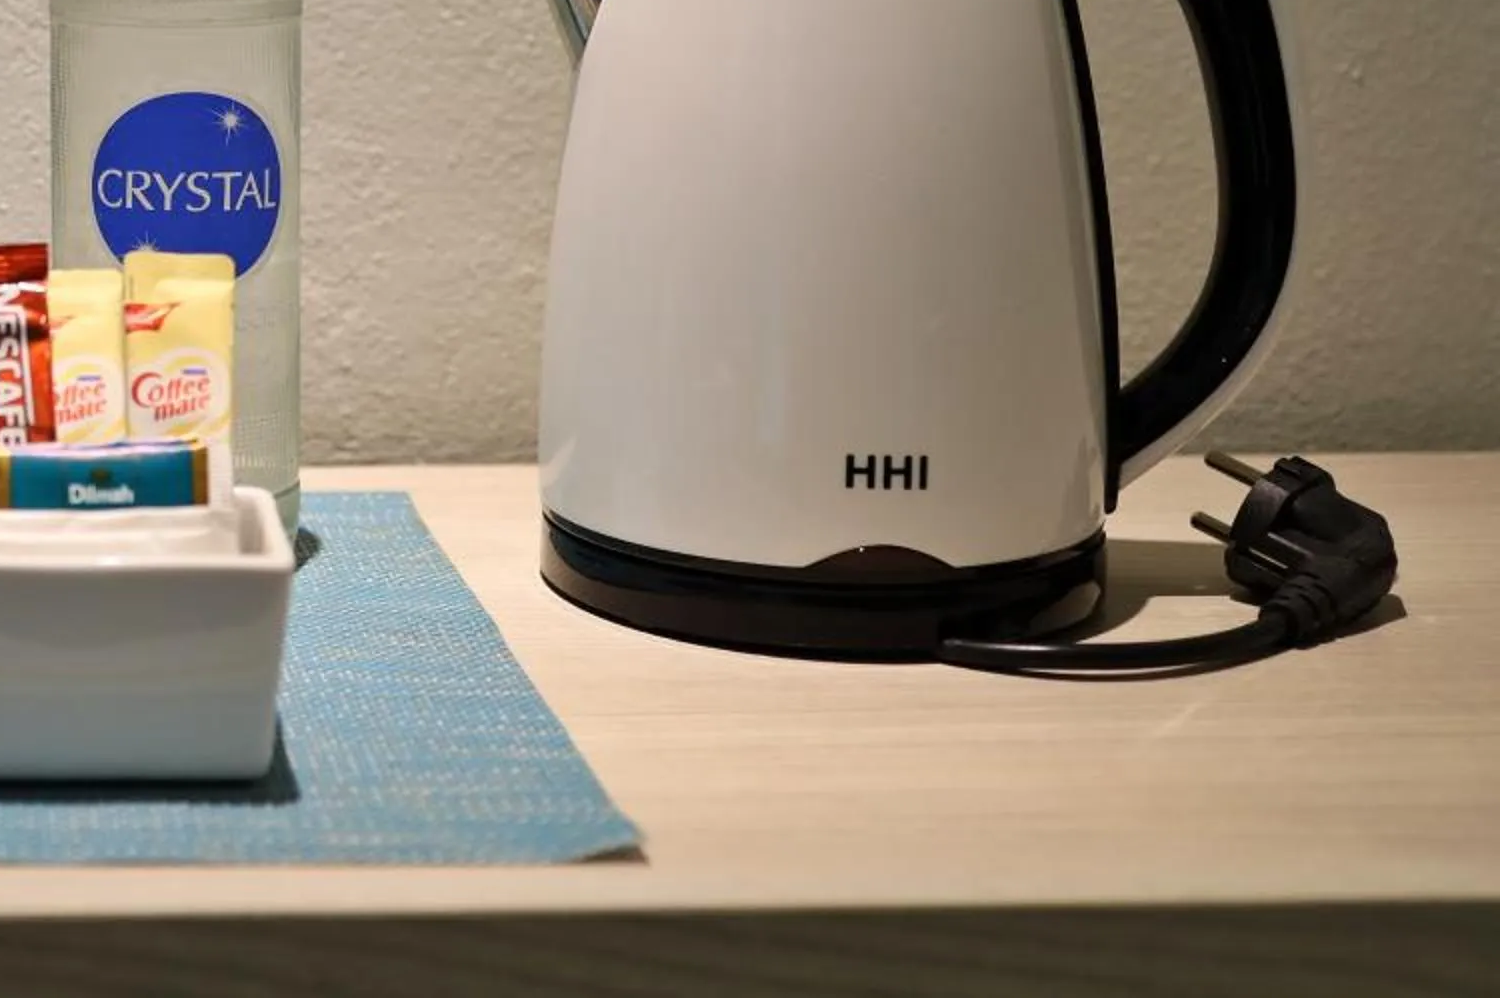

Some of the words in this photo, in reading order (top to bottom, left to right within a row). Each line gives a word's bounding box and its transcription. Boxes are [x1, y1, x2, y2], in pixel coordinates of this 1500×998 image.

[97, 168, 276, 212] CRYSTAL
[132, 371, 211, 409] Coffee
[153, 395, 211, 422] mate
[845, 454, 929, 490] HHI
